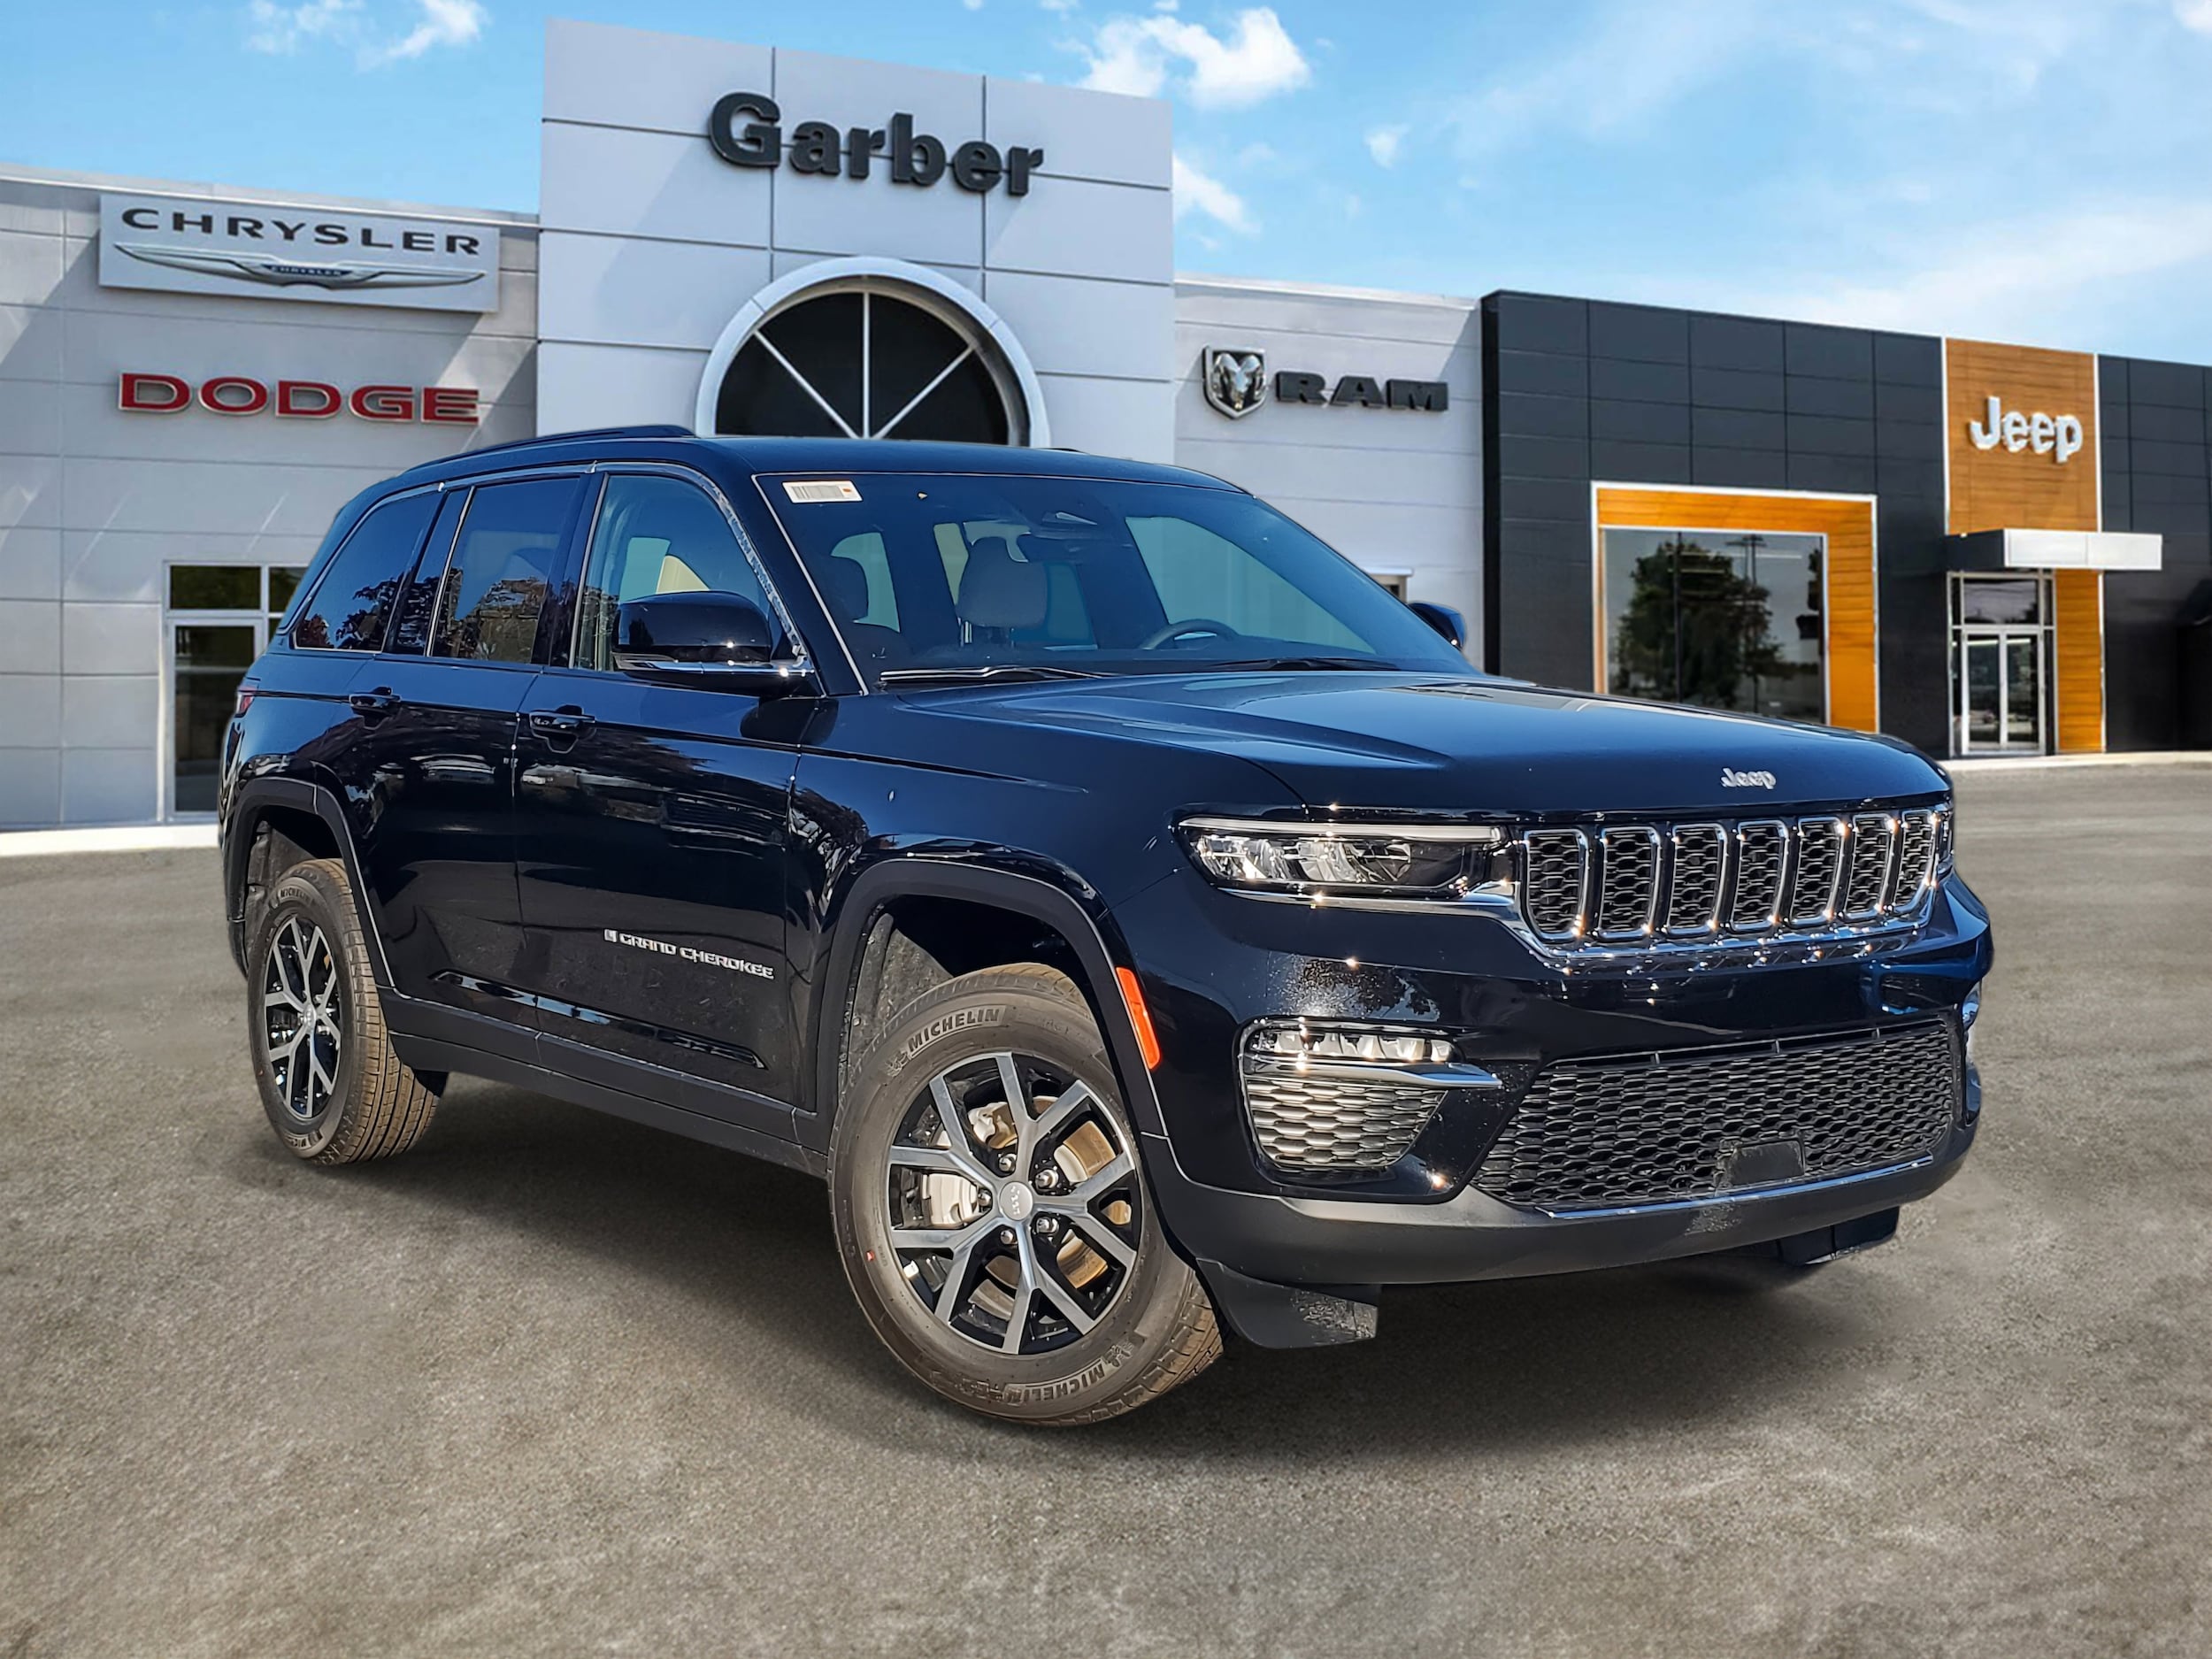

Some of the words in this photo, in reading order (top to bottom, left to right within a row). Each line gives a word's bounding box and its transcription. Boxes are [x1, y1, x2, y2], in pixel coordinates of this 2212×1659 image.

[709, 92, 1043, 196] Garber
[121, 208, 480, 255] CHRYSLER
[118, 373, 479, 425] DODGE
[1275, 371, 1448, 412] RAM
[1970, 396, 2084, 463] Jeep
[1720, 767, 1777, 790] Jeep
[619, 933, 677, 956] GRAND
[680, 947, 774, 980] CHEROKEE
[908, 1009, 1000, 1052] MICHELIN
[1007, 1363, 1105, 1404] MICHELIN
